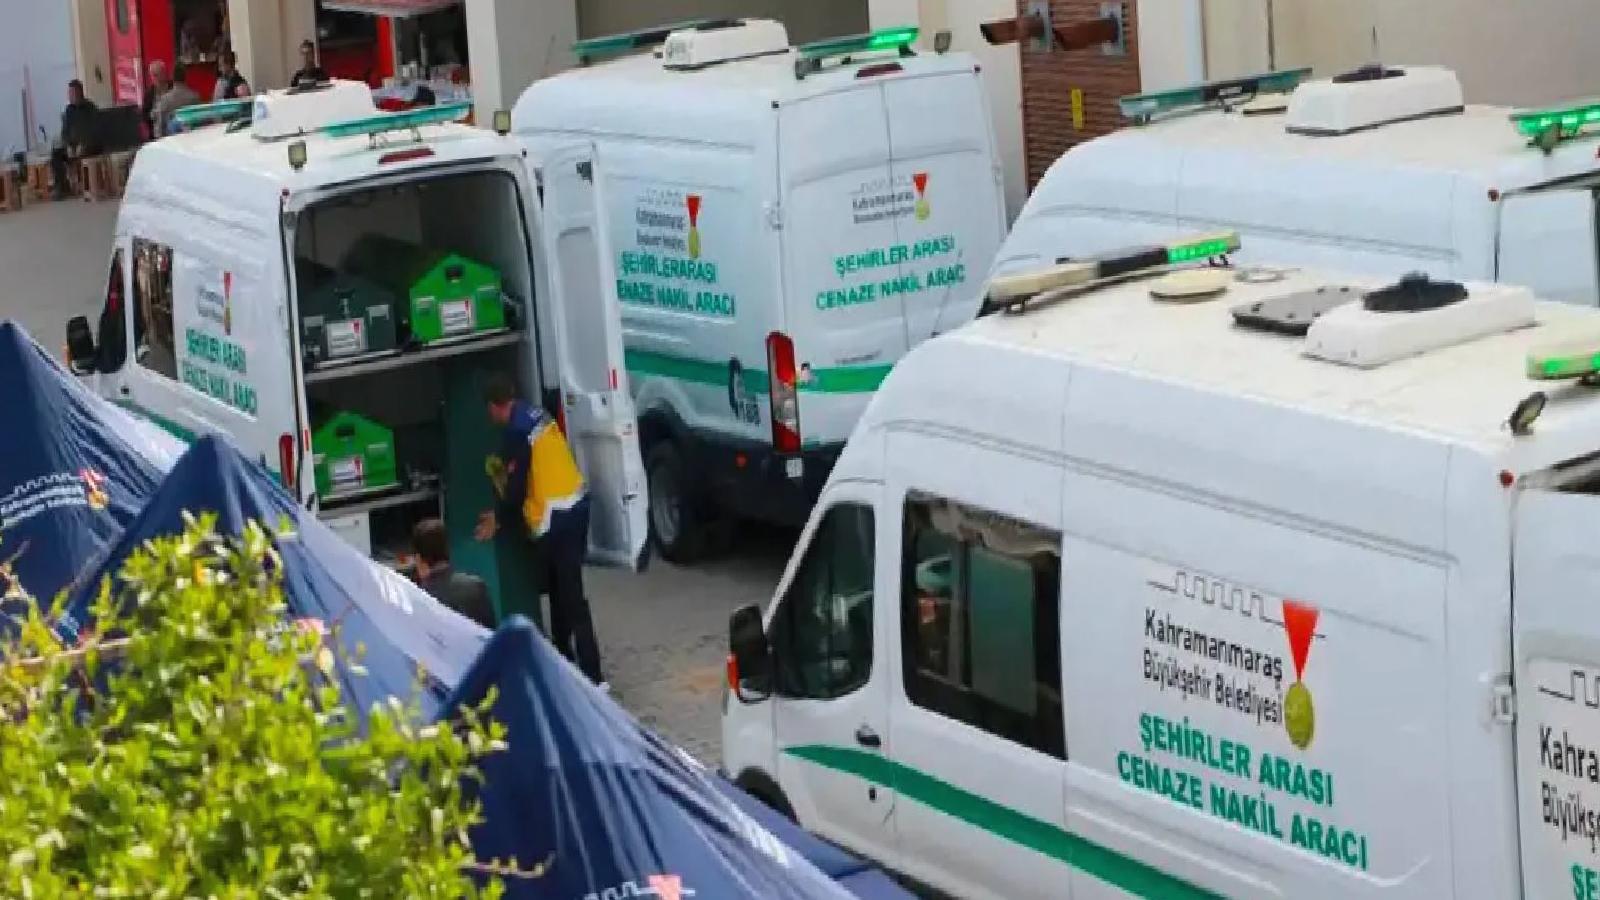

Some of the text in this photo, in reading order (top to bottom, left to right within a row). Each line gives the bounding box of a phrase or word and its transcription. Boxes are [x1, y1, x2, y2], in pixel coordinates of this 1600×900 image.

[1143, 647, 1283, 726] Büyükşehir Belediyesi
[1144, 606, 1283, 690] Kahramanmaraş
[1140, 712, 1334, 808] ŞEHİRLER ARASI
[1117, 750, 1367, 871] CENAZE NAKİL ARACI
